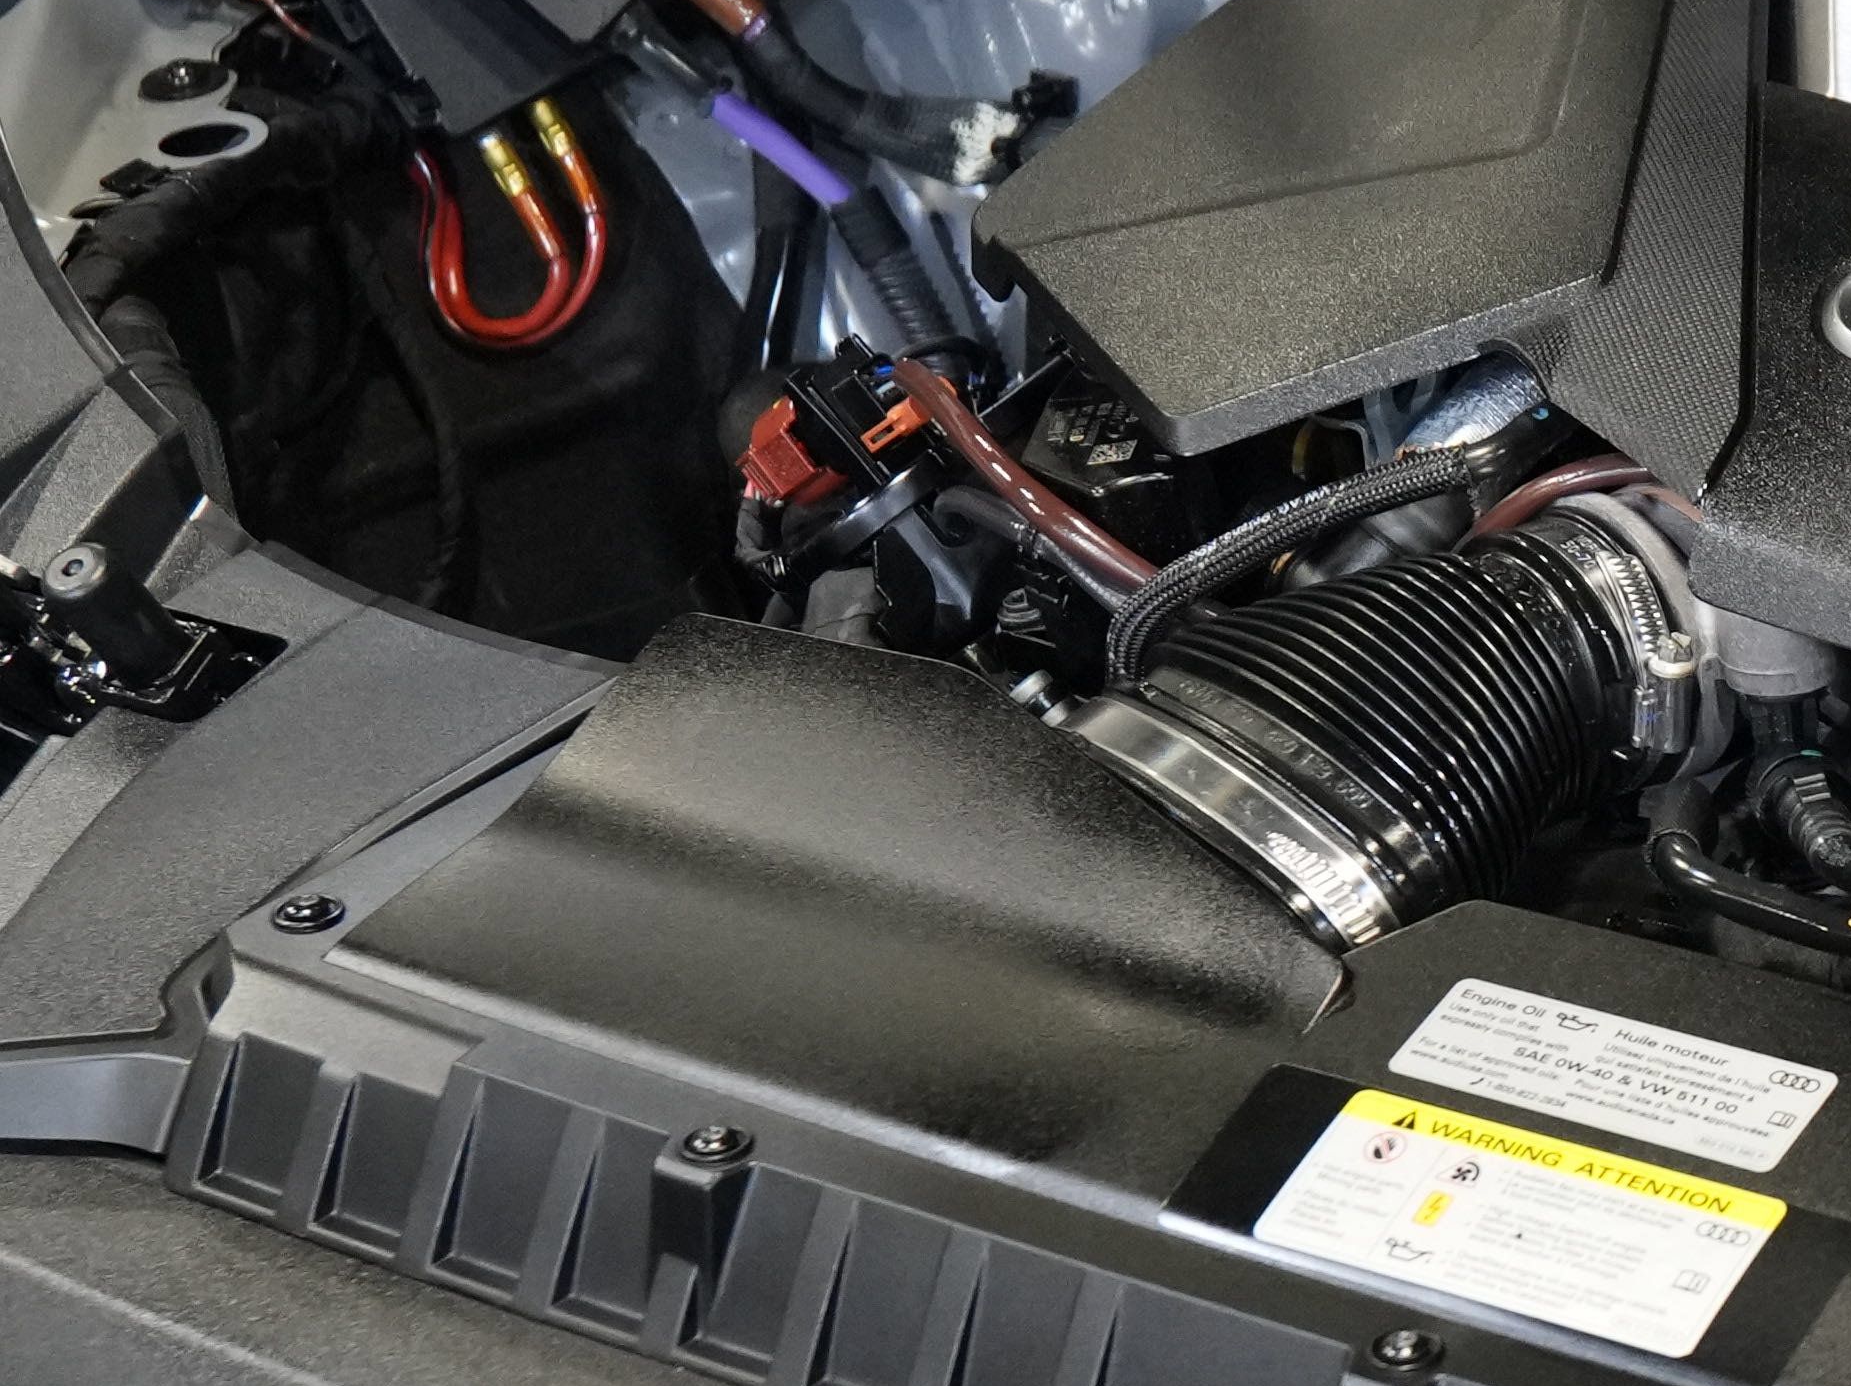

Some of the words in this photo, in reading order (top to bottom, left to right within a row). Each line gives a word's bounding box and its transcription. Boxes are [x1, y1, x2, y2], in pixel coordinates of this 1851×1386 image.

[1449, 1003, 1471, 1014] Use
[1460, 988, 1518, 1011] Engine
[1522, 1005, 1547, 1018] Oil
[1614, 1029, 1658, 1048] Huile
[1662, 1043, 1729, 1066] moteur
[1513, 1046, 1552, 1064] SAE
[1554, 1057, 1614, 1080] 0W-40
[1616, 1075, 1632, 1086] &
[1640, 1079, 1674, 1096] VW
[1714, 1100, 1739, 1114] 00
[1431, 1120, 1562, 1167] WARNING
[1574, 1162, 1732, 1213] ATTENTION
